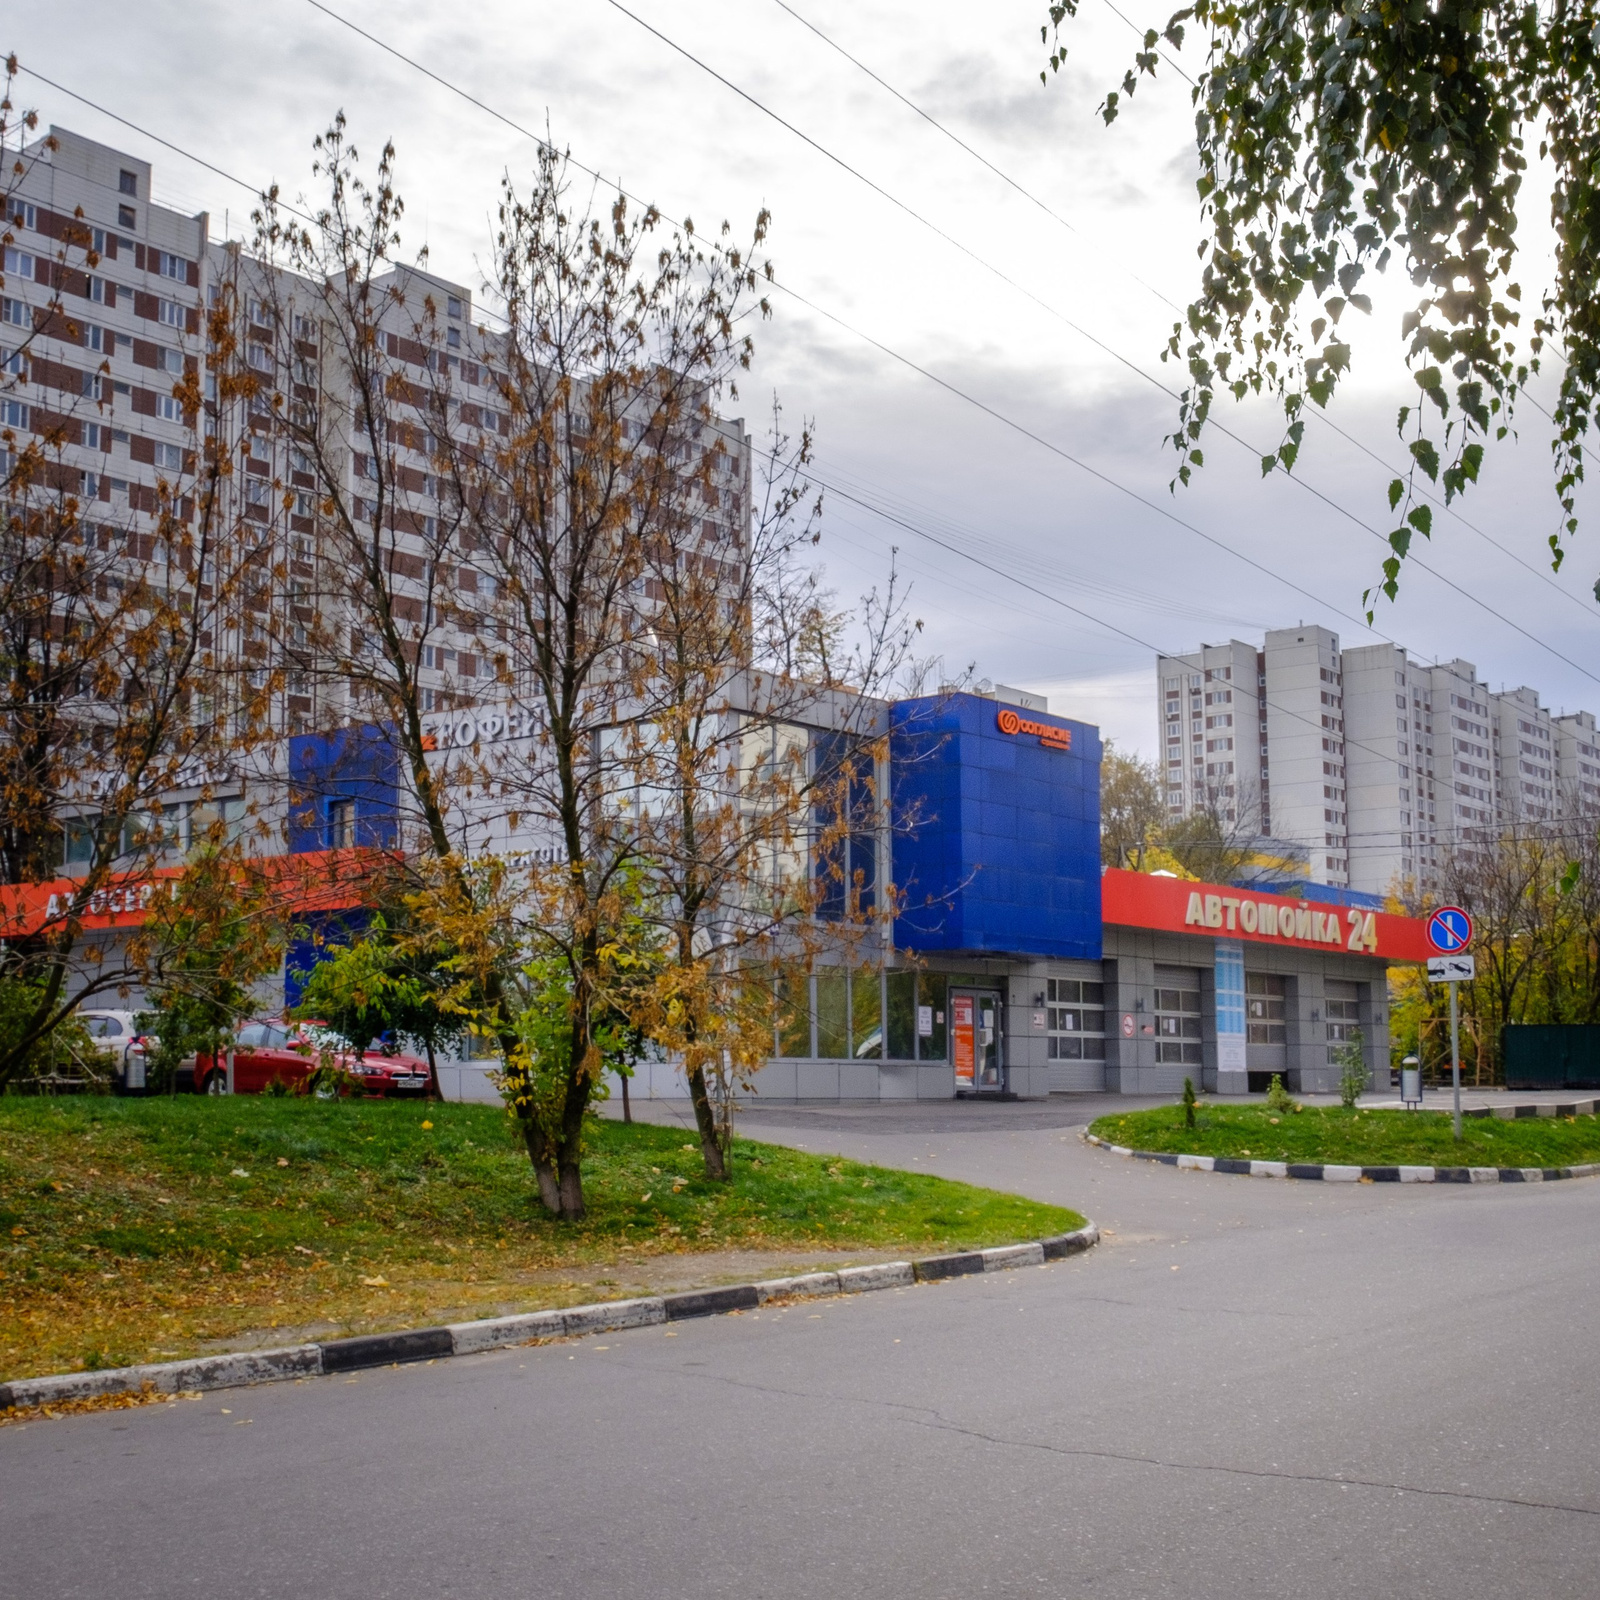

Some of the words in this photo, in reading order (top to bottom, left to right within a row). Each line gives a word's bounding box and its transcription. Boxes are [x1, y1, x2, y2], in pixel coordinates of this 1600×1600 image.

[1019, 718, 1072, 743] СОГЛАСИЕ
[1185, 891, 1342, 945] АВТОМОЙКА
[1347, 909, 1378, 953] 24
